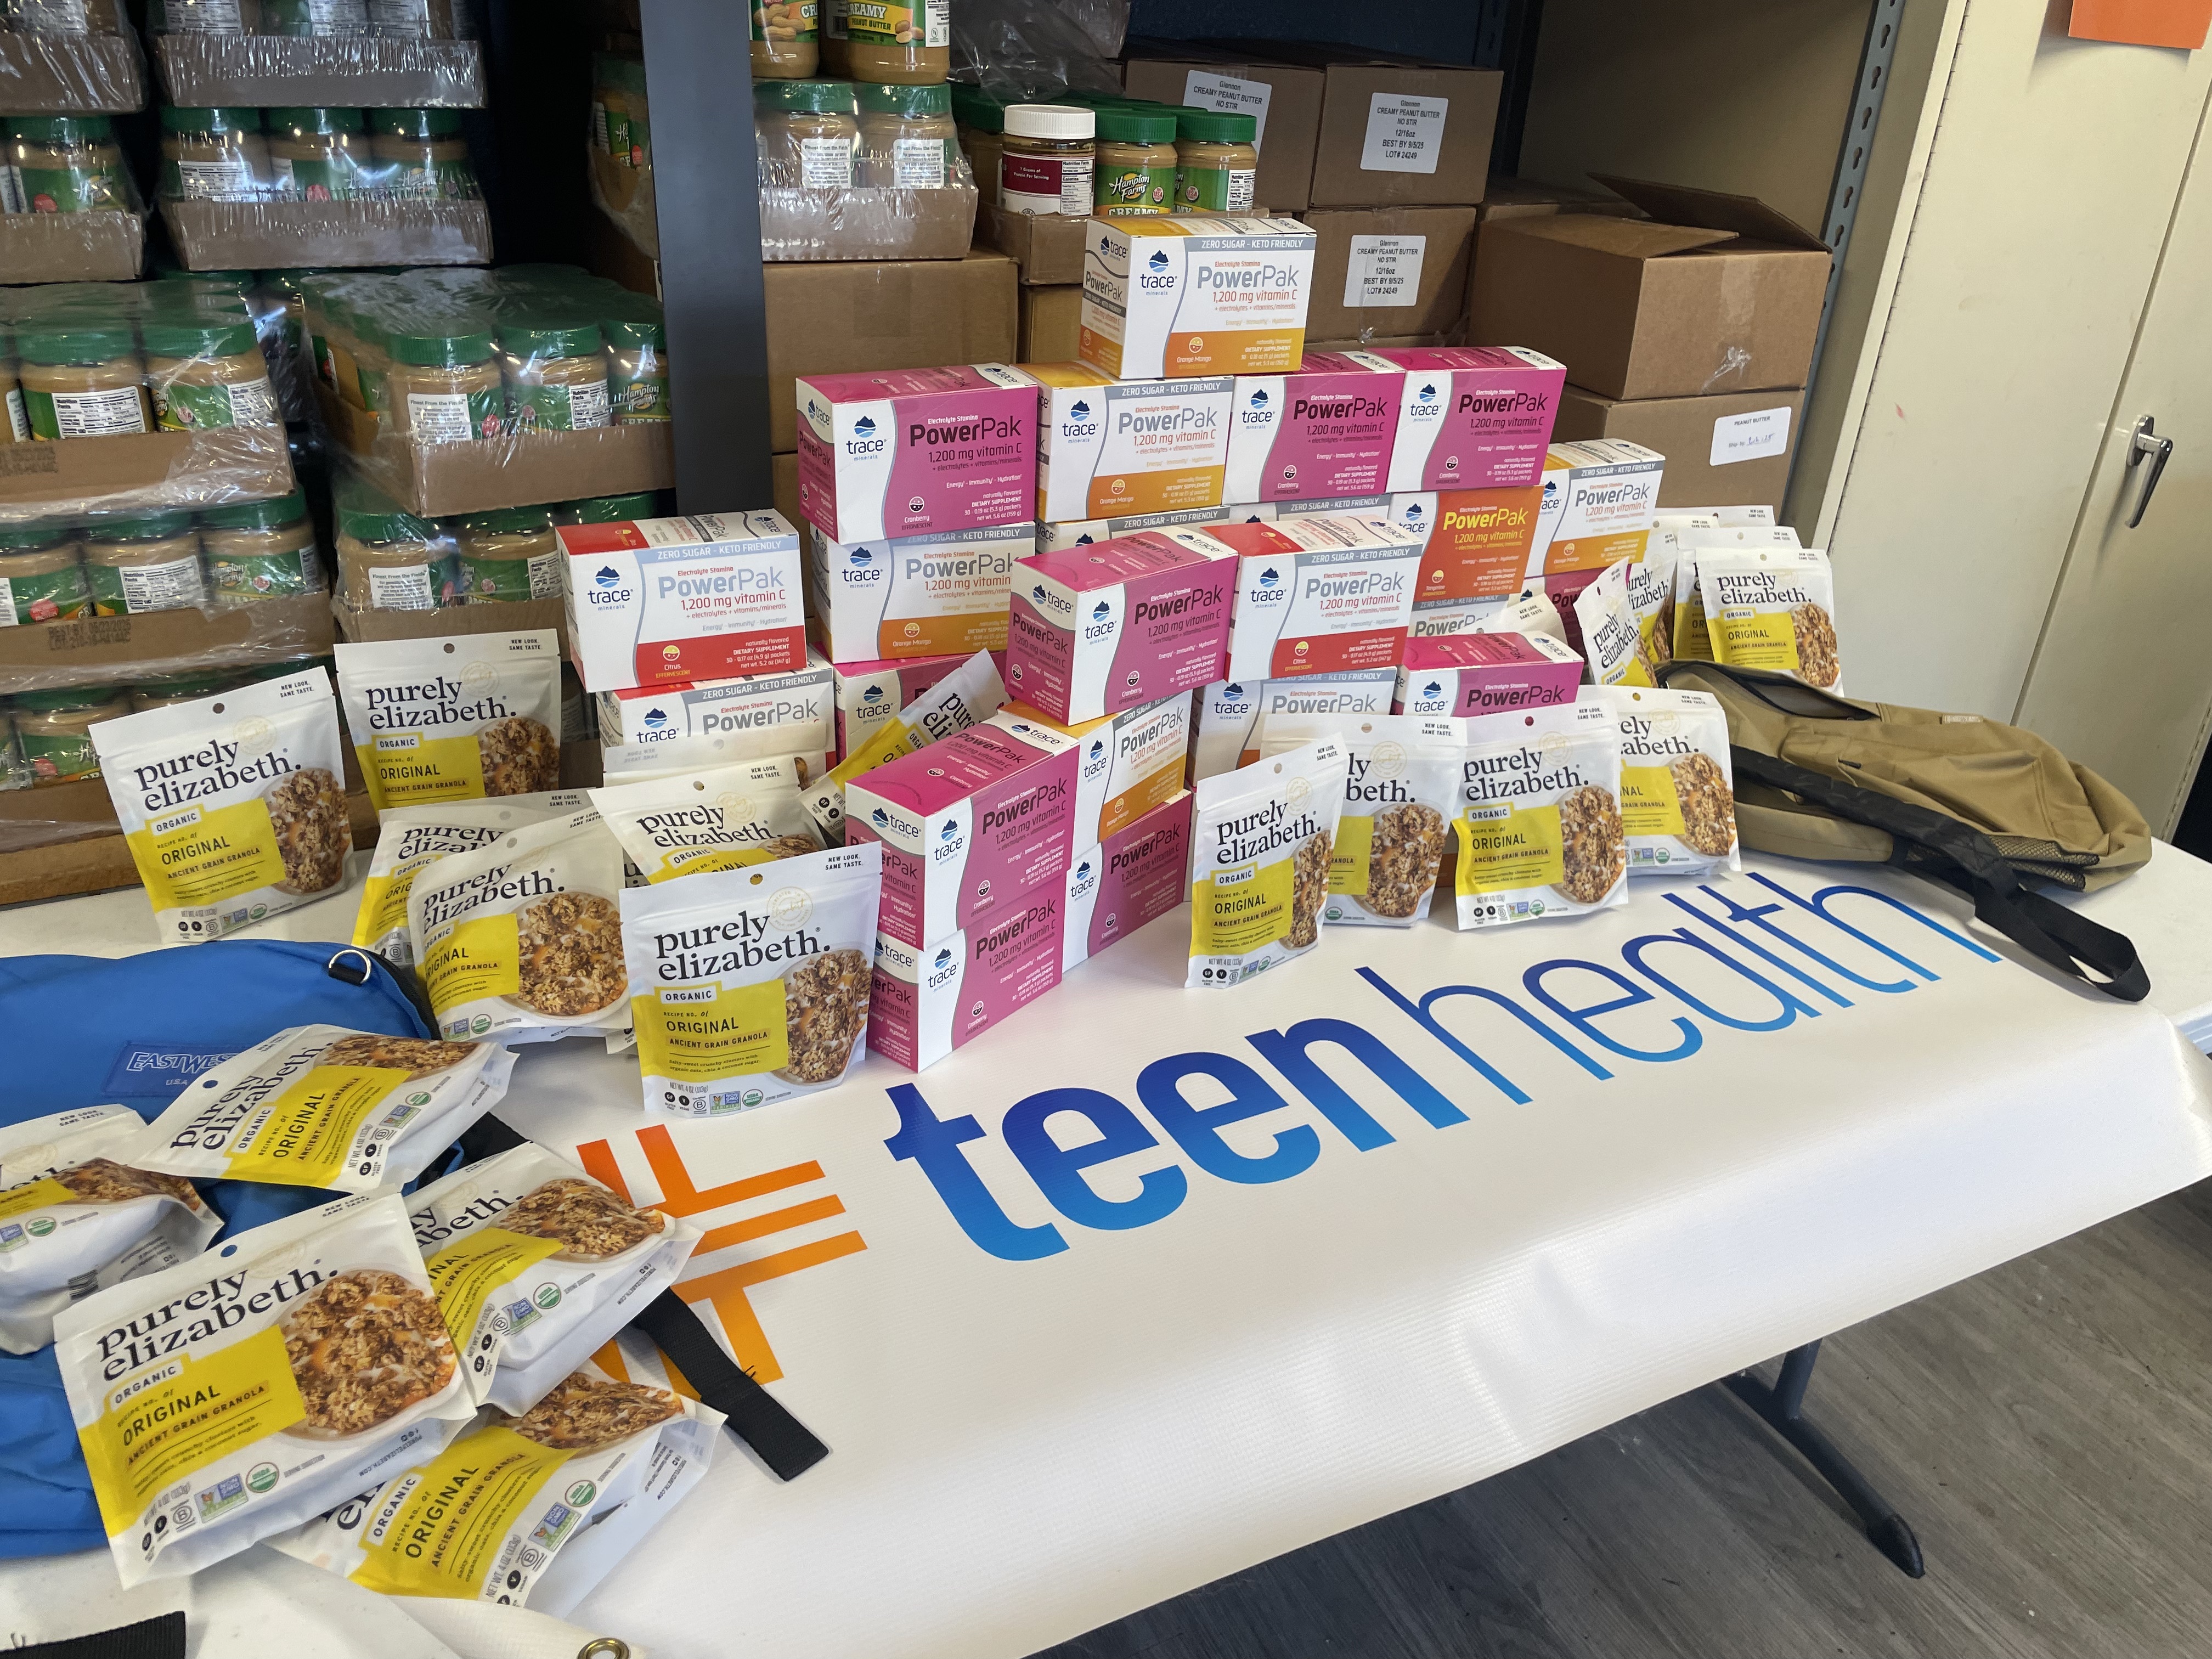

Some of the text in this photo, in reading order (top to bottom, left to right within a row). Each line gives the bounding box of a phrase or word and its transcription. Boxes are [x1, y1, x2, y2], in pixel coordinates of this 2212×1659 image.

[851, 17, 891, 31] PEANUT BUTTER
[1194, 86, 1262, 105] CREAMY PEANUT BUTTER
[1220, 81, 1241, 91] Glennon
[1227, 101, 1238, 110] STIR
[1377, 108, 1398, 116] CREAMY
[1396, 129, 1415, 138] 12/16oz
[1408, 141, 1424, 149] 9/5/25
[1109, 173, 1150, 195] Hampton
[1121, 184, 1147, 202] Farms
[1201, 240, 1303, 249] ZERO SUGAR KETO FRIENDLY
[1122, 382, 1221, 396] ZERO SUGAR KETO FRIENDLY
[910, 415, 1022, 447] PowerPak
[929, 442, 1022, 464] 1,200 mg vitamin C
[1633, 463, 1655, 472] FRIENDLY
[1124, 511, 1218, 528] ZERO SUGAR KETO FRIENDLY
[963, 529, 1020, 539] KETO FRIENDLY
[658, 540, 782, 560] ZERO SUGAR KETO FRIENDLY
[1312, 548, 1410, 563] ZERO SUGAR KETO FRIENDLY
[658, 566, 784, 599] PowerPak
[678, 568, 708, 577] Electrolyte
[1306, 572, 1404, 599] PowerPak
[1717, 572, 1776, 596] purely
[681, 589, 786, 611] 1,200 mg vitamin C
[692, 603, 787, 619] electrolytes vitamins/minerals
[746, 639, 768, 647] naturally
[1593, 613, 1621, 654] purely
[1728, 629, 1769, 640] ORIGINAL
[733, 644, 789, 656] DIETARY SUPPLEMENT
[656, 670, 691, 679] EFFERVESCENT
[365, 676, 462, 710] purely
[703, 674, 817, 699] ZERO SUGAR KETO FRIENDLY
[380, 739, 415, 748] ORGANIC
[134, 739, 239, 792] purely
[380, 764, 441, 780] ORIGINAL
[1463, 747, 1543, 783] purely
[982, 777, 1067, 835] PowerPak
[1472, 809, 1508, 820] ORGANIC
[156, 812, 197, 832] ORGANIC
[636, 805, 725, 834] purely
[1216, 799, 1289, 845] purely
[161, 836, 230, 865] ORIGINAL
[1109, 823, 1180, 874] PowerPak
[1472, 833, 1526, 850] ORIGINAL
[167, 848, 261, 879] ANCIENT GRAIN GRANOLA
[842, 860, 863, 868] TASTE.
[1219, 871, 1252, 884] ORGANIC
[424, 864, 513, 916] purely
[1215, 894, 1266, 915] ORIGINAL
[1214, 905, 1282, 927] ANCIENT GRAIN GRANOLA
[654, 910, 770, 959] purely
[976, 898, 1056, 960] PowerPak
[461, 962, 498, 970] GRANOLA
[658, 932, 831, 981] elizabeth.
[665, 990, 712, 1001] ORGANIC
[666, 1017, 739, 1032] ORIGINAL
[669, 1031, 768, 1048] ANCIENT GRAIN GRANOLA
[126, 1052, 240, 1074] EASTWES
[884, 870, 2002, 1264] teenhealth
[171, 1074, 263, 1149] purely
[238, 1108, 272, 1149] ORGANIC
[272, 1092, 326, 1158] ORIGINAL
[97, 1269, 249, 1362] purely
[114, 1365, 178, 1403] ORGANIC
[123, 1385, 221, 1446] ORIGINAL
[127, 1385, 266, 1466] ANCIENT GRAIN GRANOLA
[373, 1478, 417, 1538] ORGANIC
[405, 1466, 481, 1560] ORIGINAL
